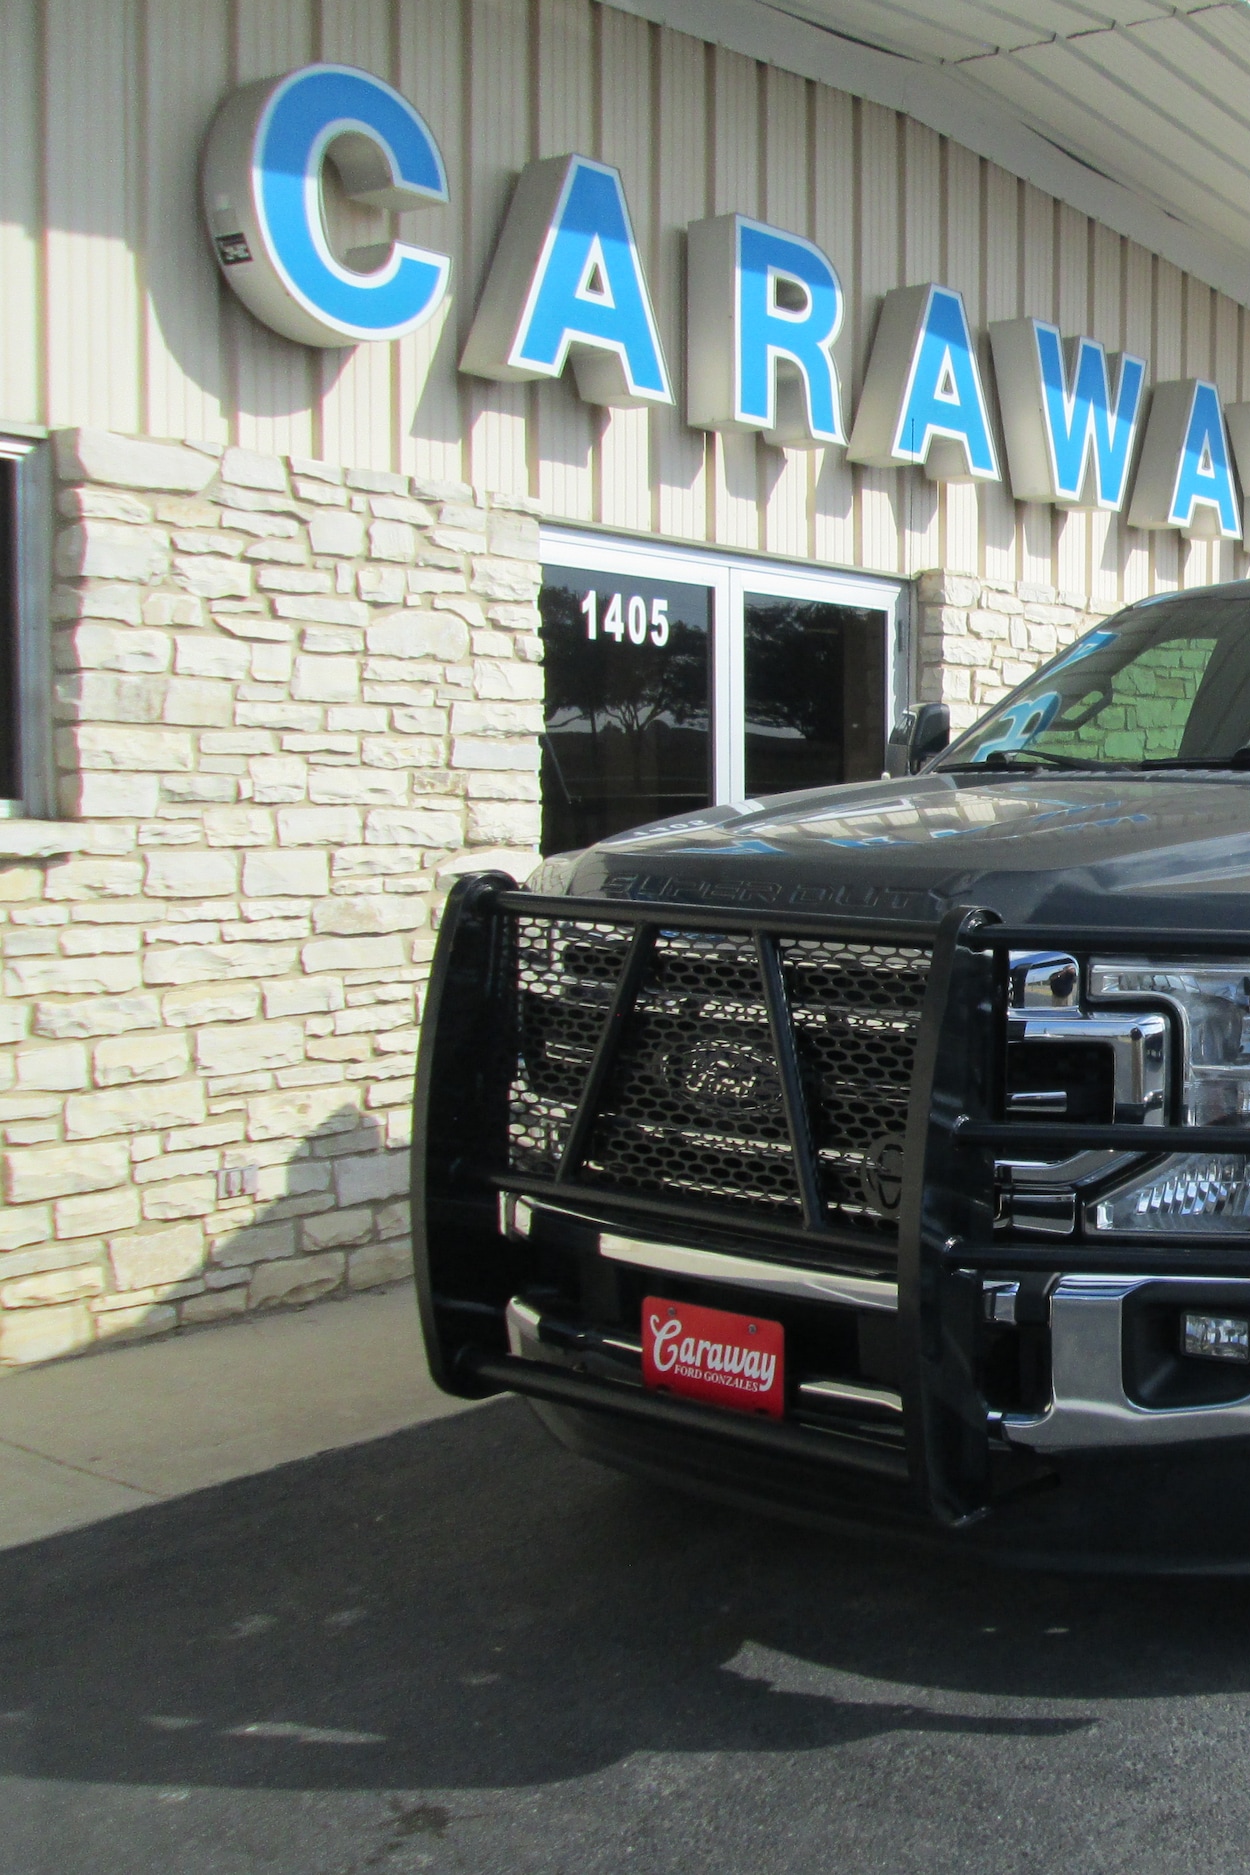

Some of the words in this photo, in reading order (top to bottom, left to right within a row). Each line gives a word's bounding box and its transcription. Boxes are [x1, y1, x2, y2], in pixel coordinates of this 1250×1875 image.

[581, 589, 669, 647] 1405
[603, 873, 782, 902] SUPER
[650, 1314, 776, 1392] Caraway
[674, 1364, 703, 1380] FORD
[703, 1371, 760, 1392] GONZALES
